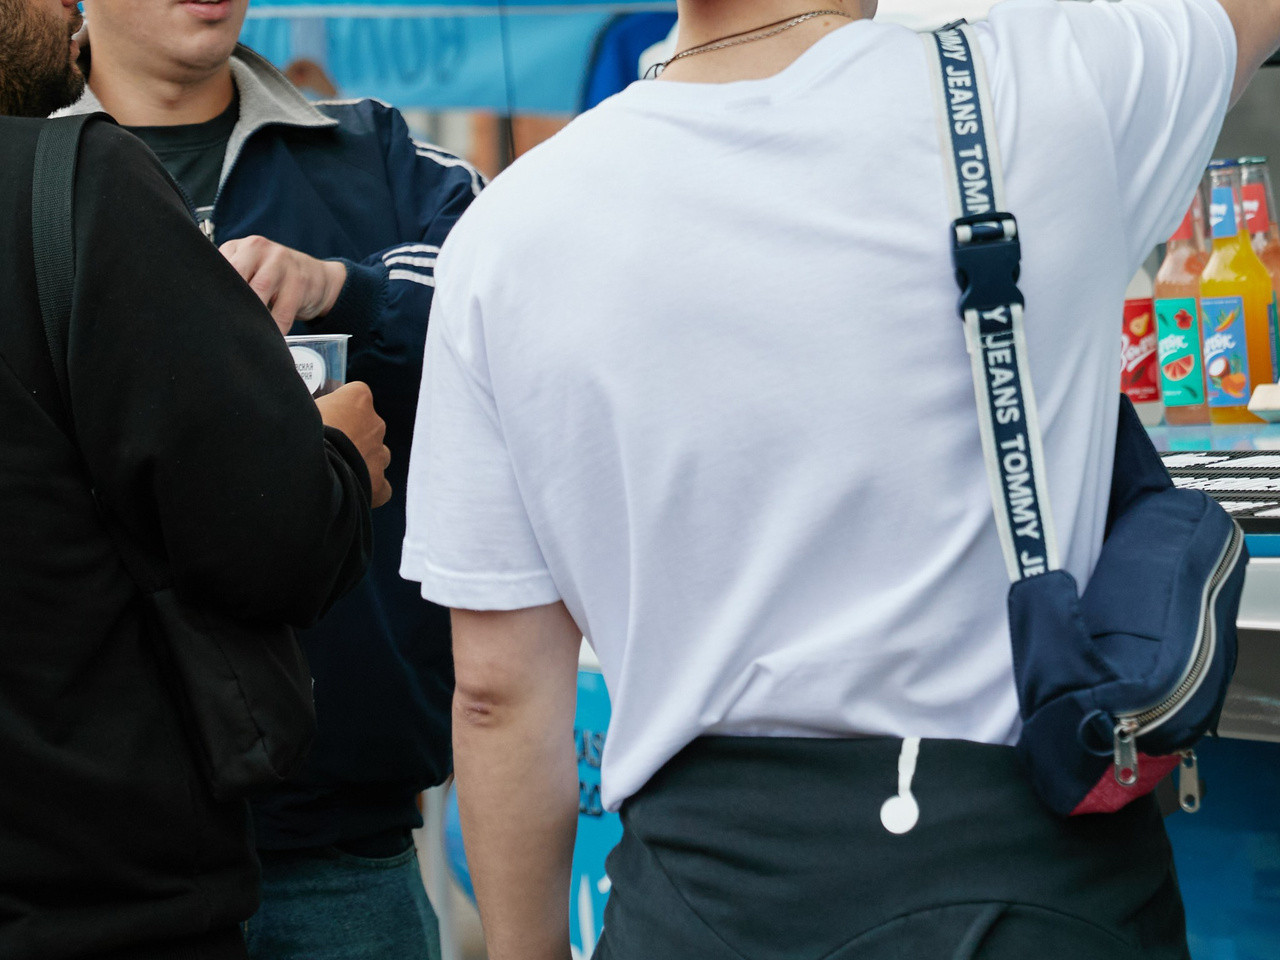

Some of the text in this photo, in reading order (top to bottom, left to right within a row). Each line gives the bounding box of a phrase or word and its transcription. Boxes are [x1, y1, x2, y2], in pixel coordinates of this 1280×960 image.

[945, 65, 978, 136] JEANS
[985, 334, 1020, 426] JEANS
[1000, 433, 1040, 540] TOMMY
